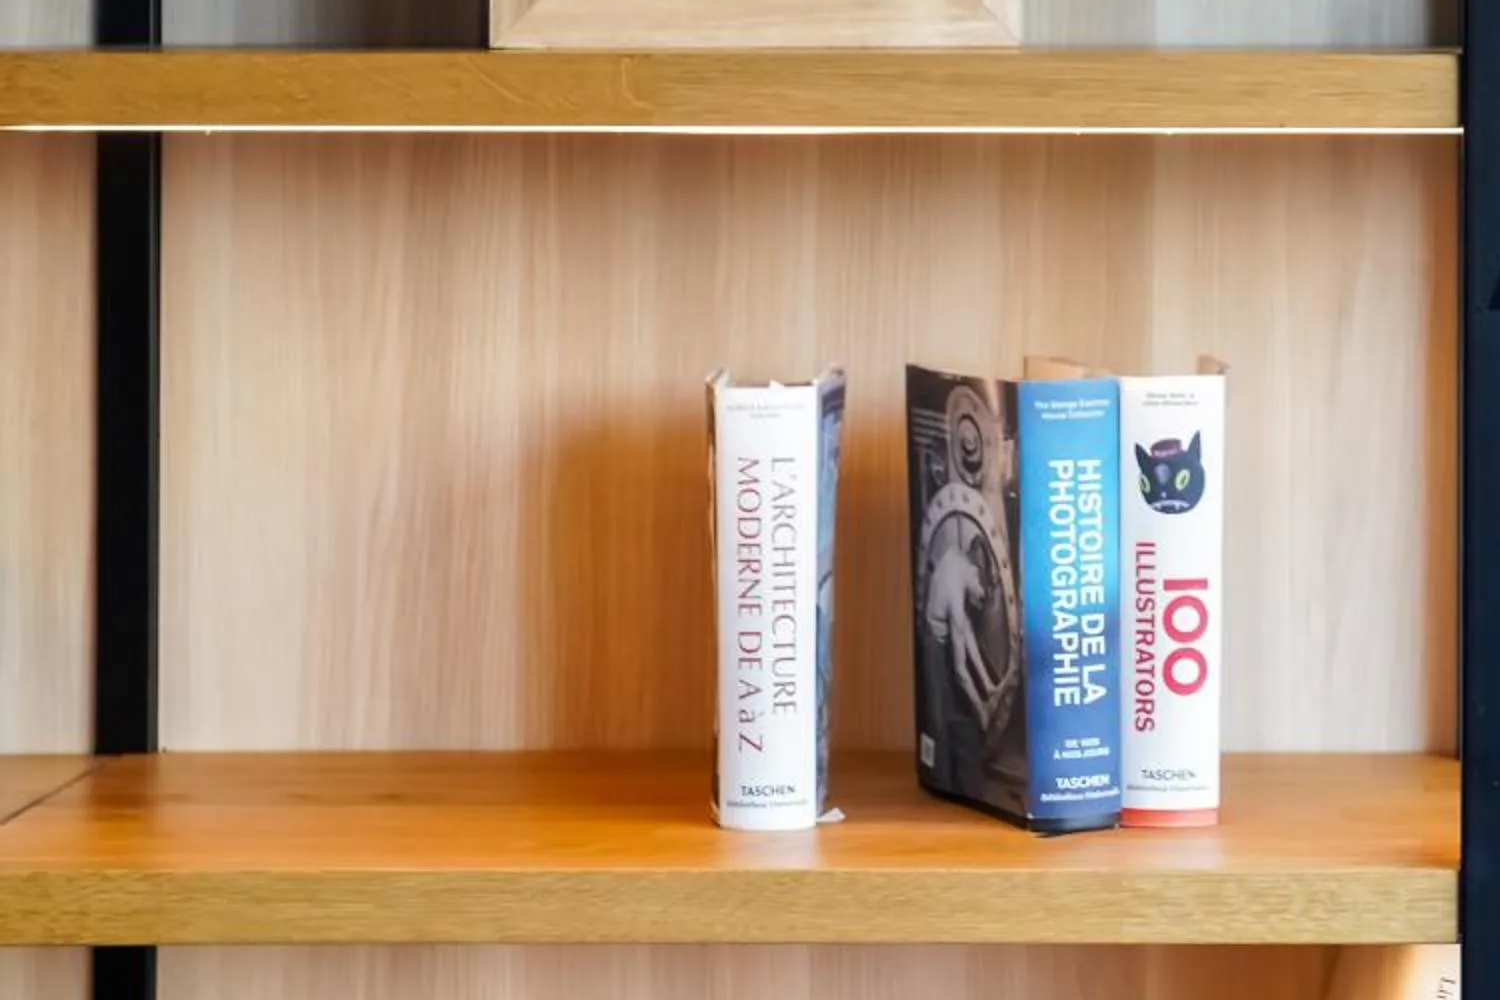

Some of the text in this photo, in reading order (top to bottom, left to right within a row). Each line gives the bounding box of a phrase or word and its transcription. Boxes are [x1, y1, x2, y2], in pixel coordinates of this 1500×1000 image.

[736, 457, 765, 752] MODERNE DE A à Z
[771, 457, 798, 715] L'ARCHITECTURE
[1048, 458, 1081, 708] PHOTOGRAPHIE
[1076, 458, 1107, 705] HISTOIRE DE LA
[1134, 541, 1156, 734] ILLUSTRATORS
[1162, 578, 1209, 697] 100
[741, 784, 795, 797] TASCHEN
[1056, 774, 1111, 789] TASCHEN
[1141, 768, 1197, 781] TASCHEN
